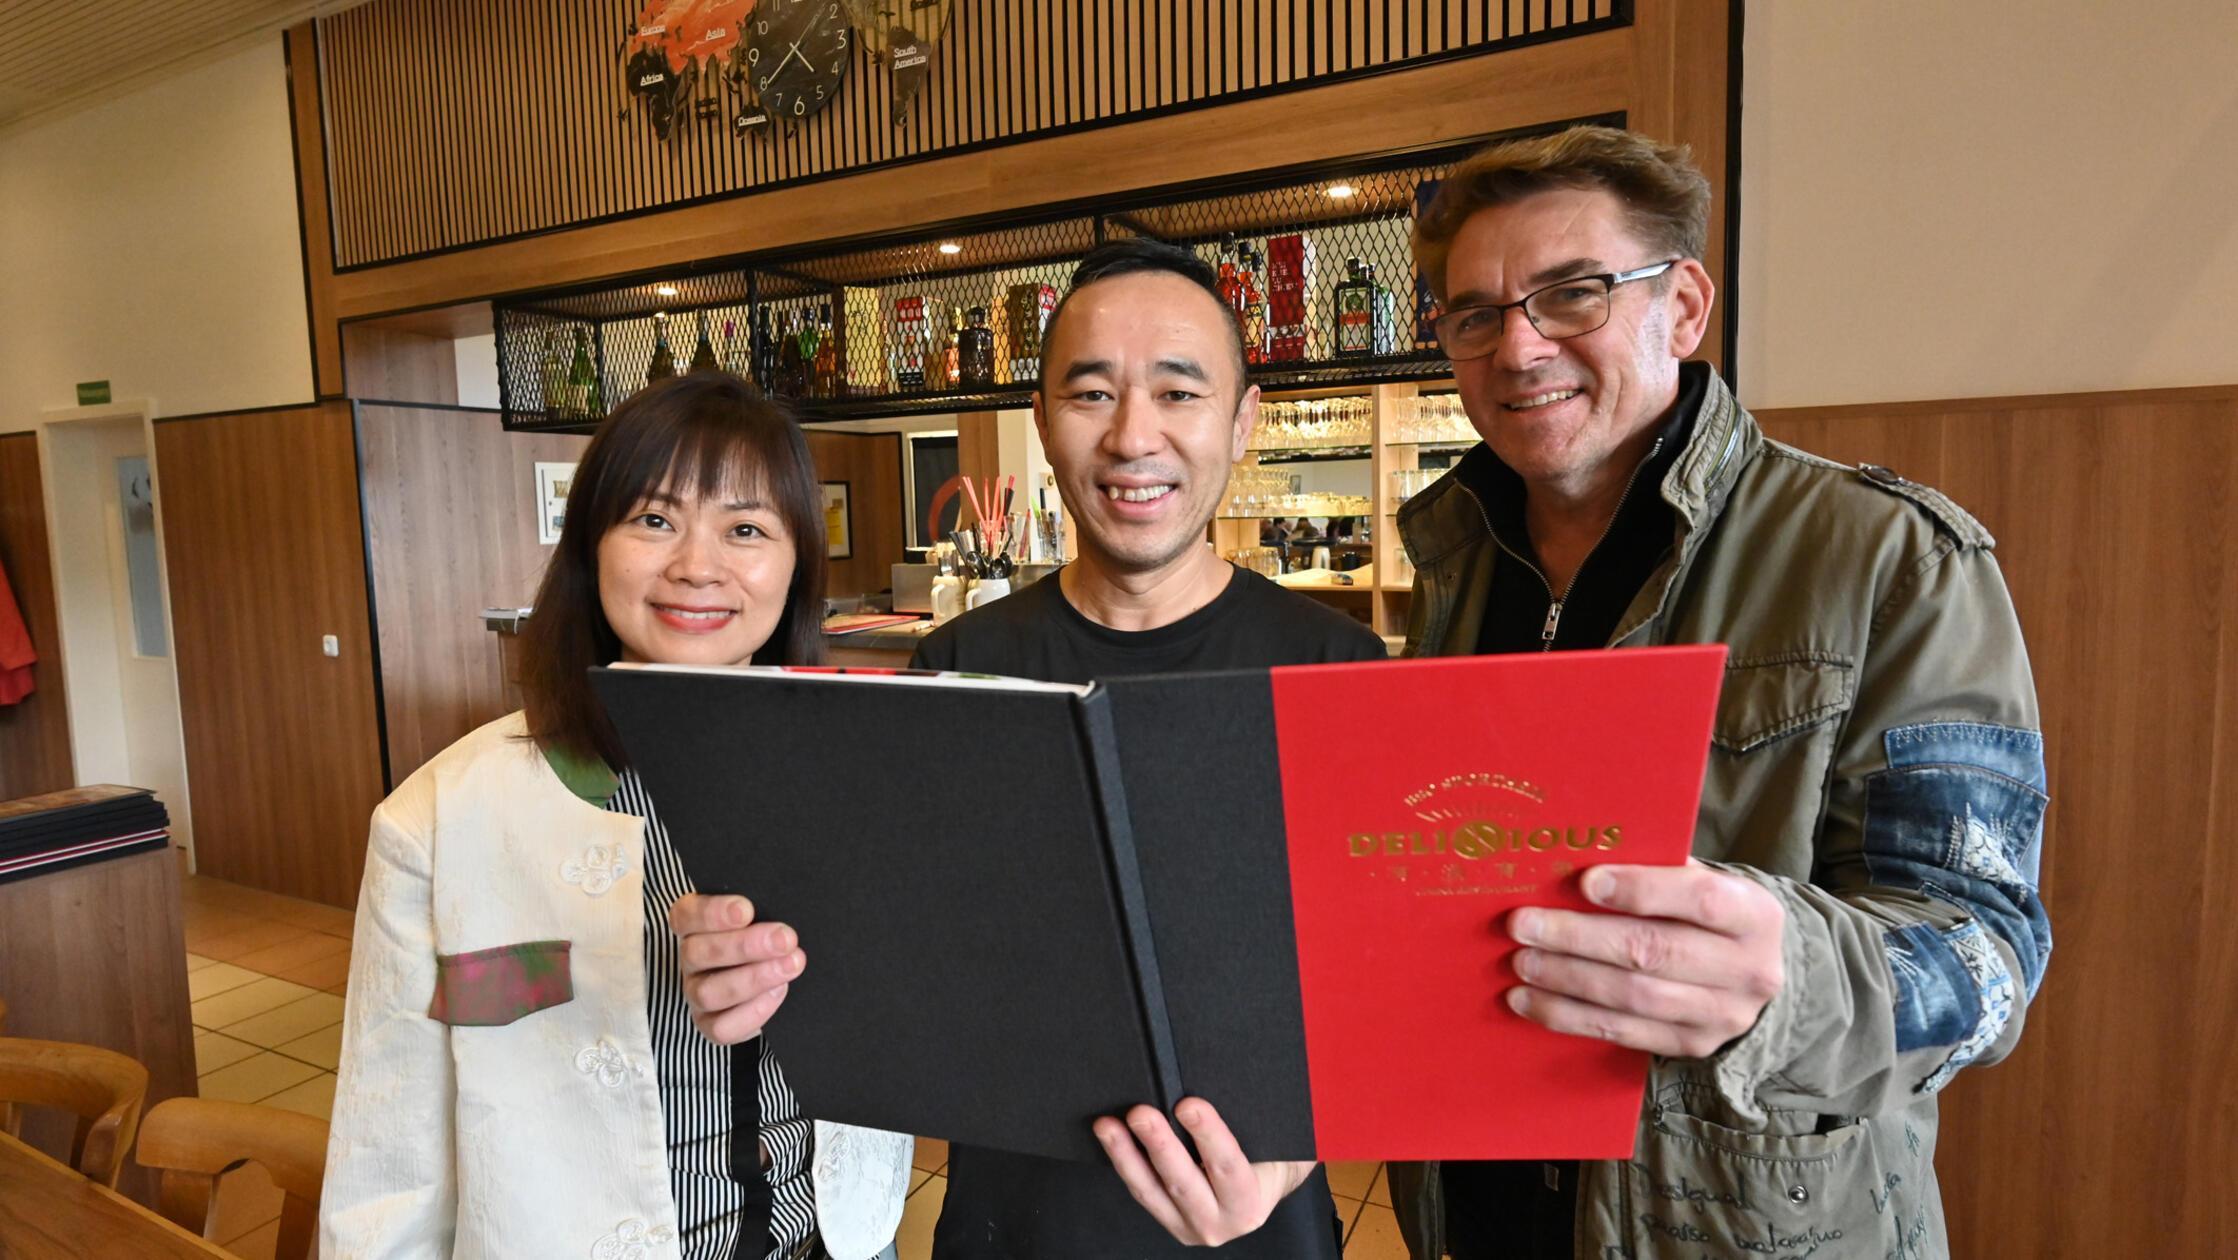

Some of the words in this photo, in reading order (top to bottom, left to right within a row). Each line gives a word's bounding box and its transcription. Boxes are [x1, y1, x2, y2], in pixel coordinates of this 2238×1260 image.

[829, 3, 839, 19] 2
[706, 28, 726, 40] Asia
[757, 20, 769, 35] 10
[837, 29, 847, 50] 3
[748, 48, 760, 67] 9
[894, 45, 917, 58] South
[831, 61, 839, 76] 4
[894, 56, 927, 70] America
[640, 73, 664, 86] Africa
[760, 76, 768, 91] 8
[776, 93, 783, 107] 7
[816, 85, 824, 100] 5
[794, 96, 805, 116] 6
